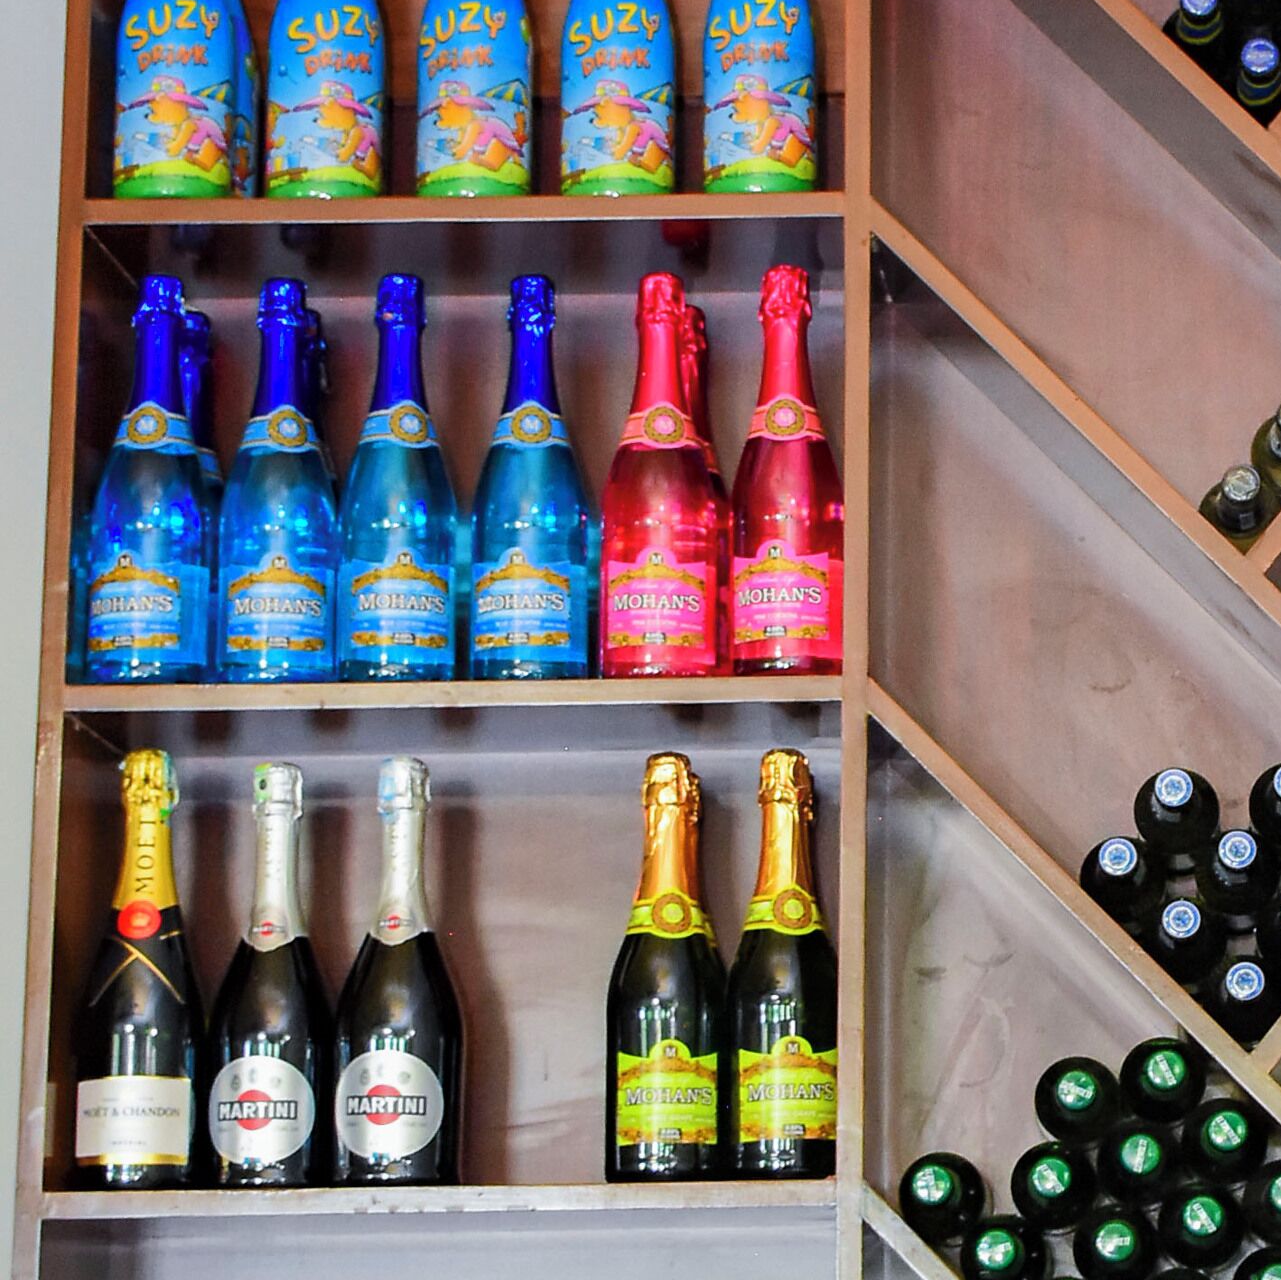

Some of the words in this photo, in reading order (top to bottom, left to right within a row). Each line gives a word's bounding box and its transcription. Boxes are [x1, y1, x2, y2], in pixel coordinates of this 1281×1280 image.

[125, 0, 219, 51] SUZY
[288, 5, 379, 54] SUZY
[420, 1, 506, 59] SUZY
[569, 2, 660, 56] SUZY
[358, 594, 445, 614] MOHAN'S
[477, 593, 565, 614] MOHAN'S
[612, 593, 700, 613] MOHAN'S
[737, 586, 822, 608] MOHAN'S
[235, 598, 321, 618] MOHAN'S
[625, 1087, 713, 1106] MOHAN'S
[748, 1083, 834, 1102] MOHAN'S
[122, 1106, 180, 1118] CHANDON
[219, 1101, 297, 1120] MARTINI
[348, 1096, 425, 1115] MARTINI
